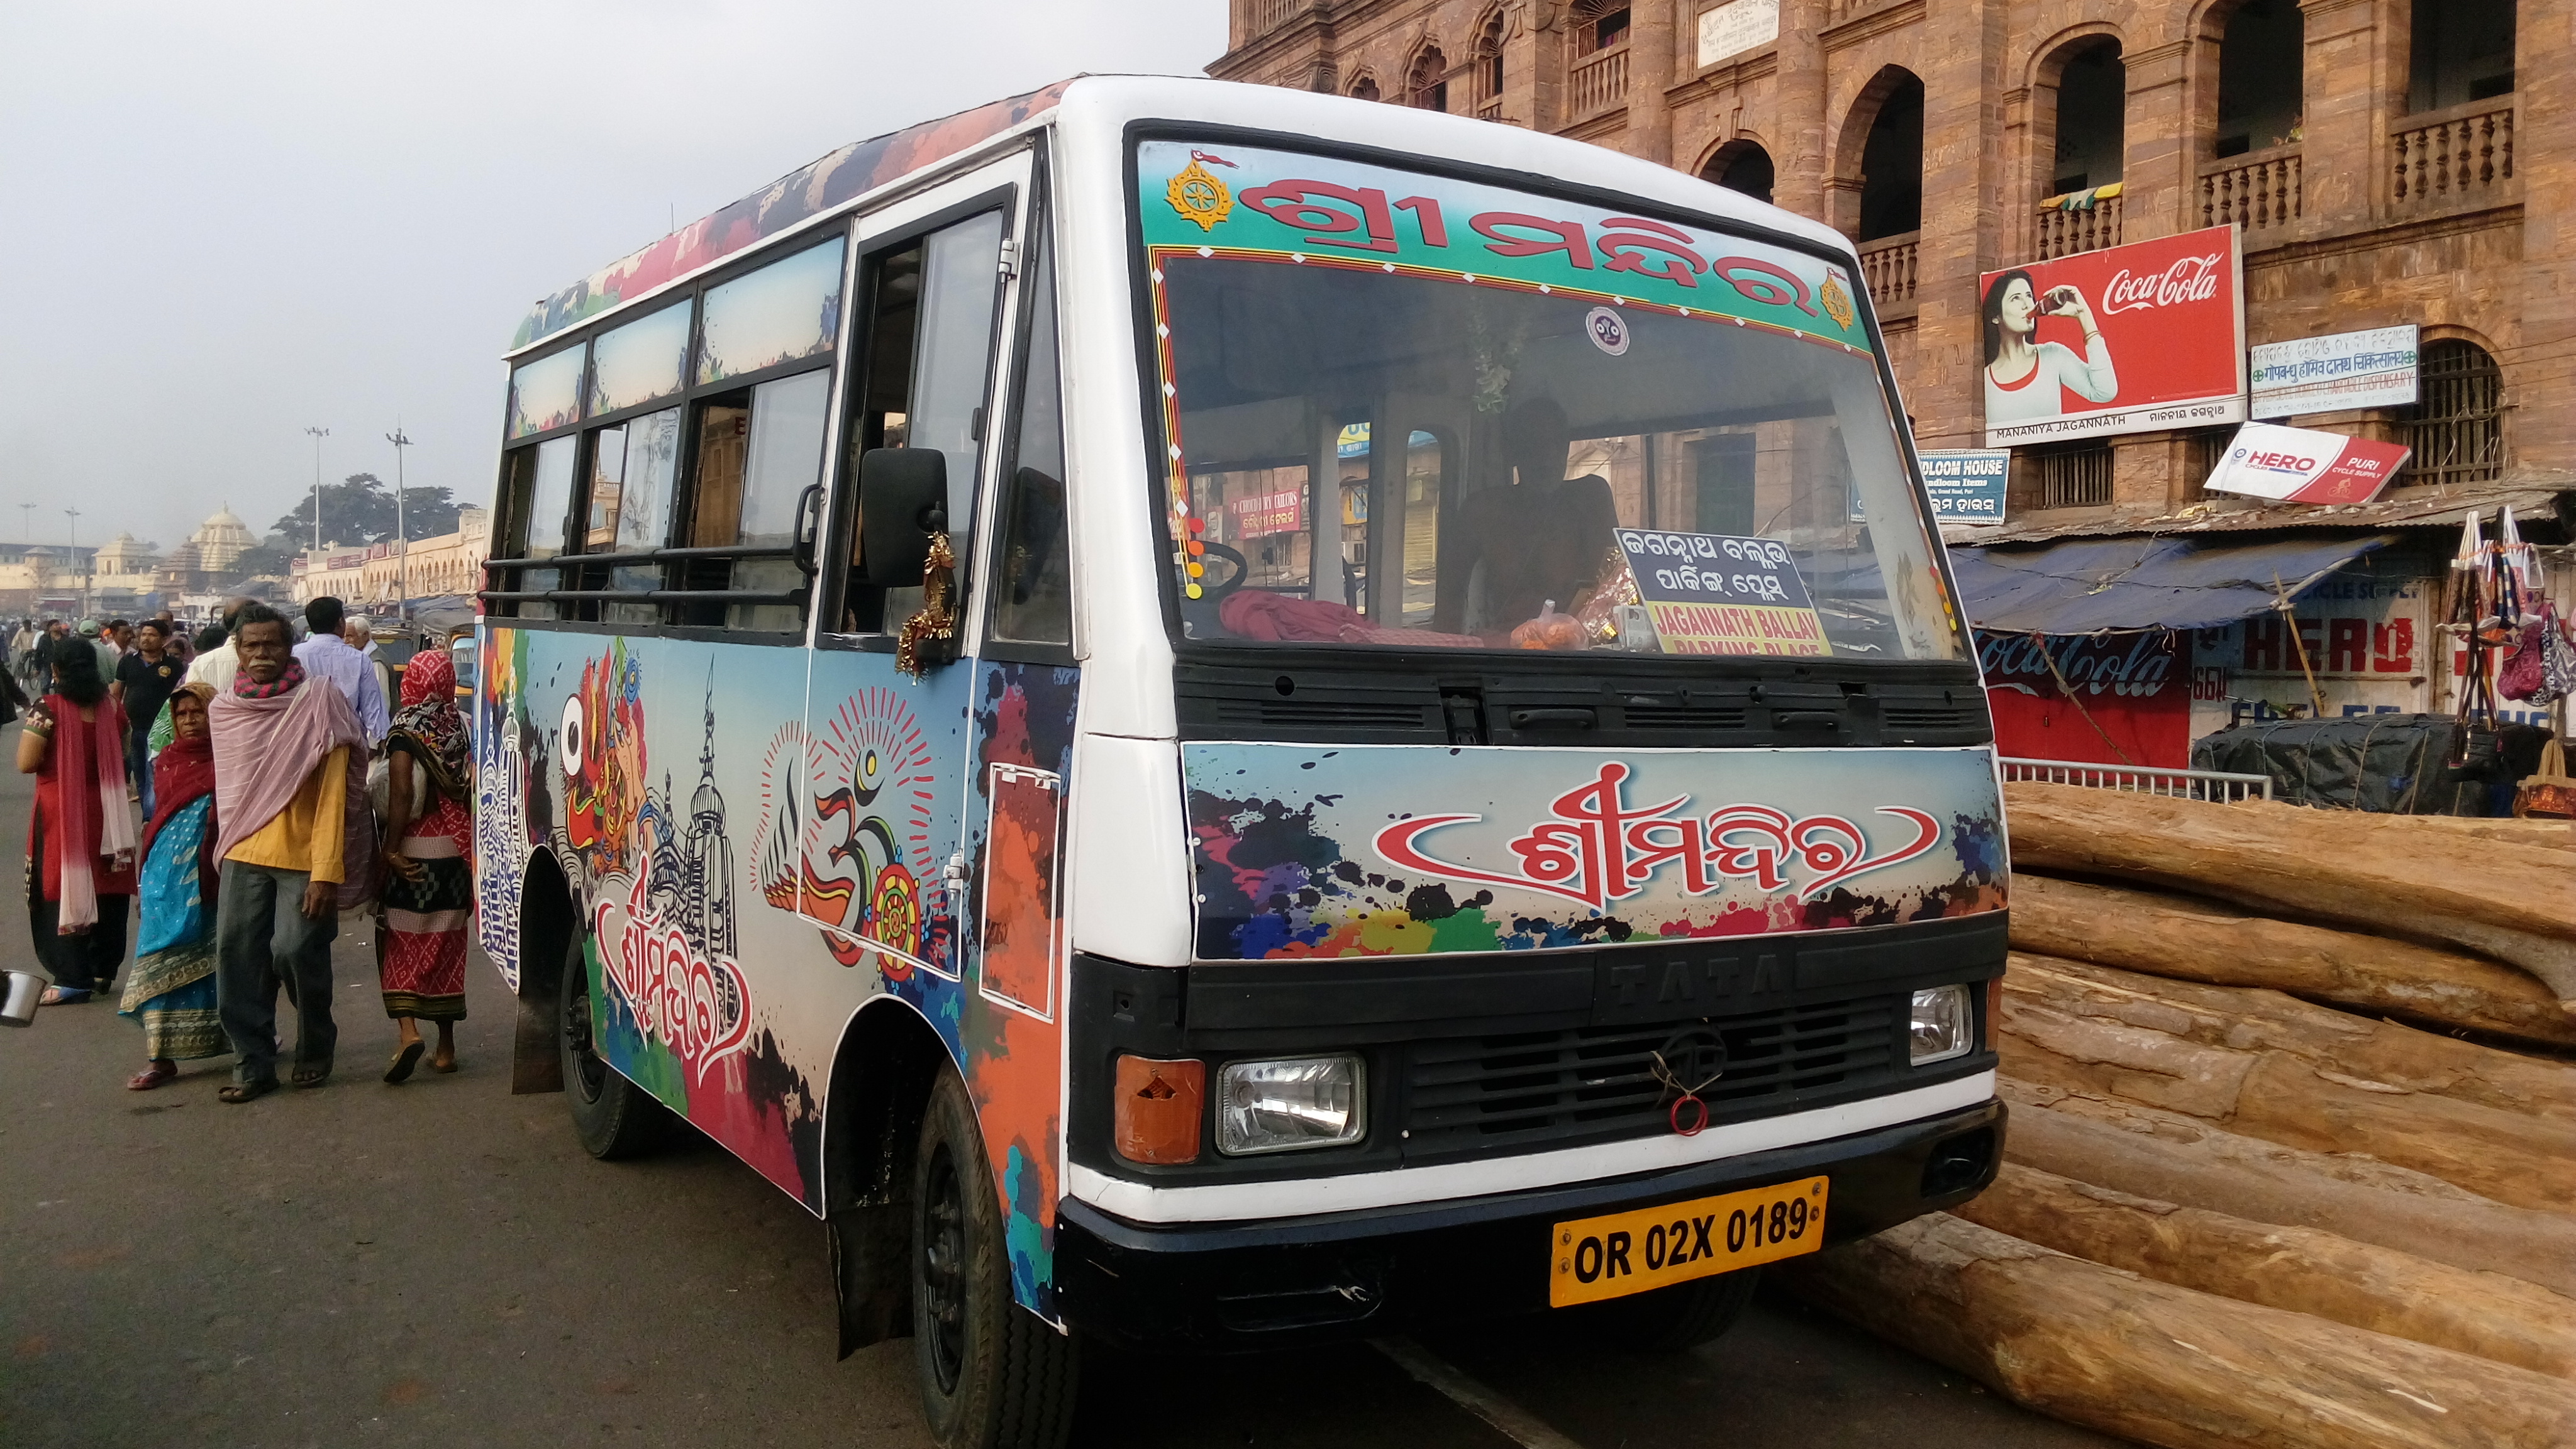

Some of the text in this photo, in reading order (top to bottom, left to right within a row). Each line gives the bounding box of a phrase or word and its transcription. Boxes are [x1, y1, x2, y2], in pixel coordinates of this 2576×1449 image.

[1238, 179, 1819, 318] ଶ୍ରୀ ମନ୍ଦିର
[2102, 252, 2224, 315] Coca-Cola
[1996, 416, 2126, 439] MANANIYA JAGANNATH
[1920, 459, 2004, 475] DLOOM HOUSE
[2248, 450, 2316, 471] HERO
[2332, 467, 2382, 479] CYCLE SUPPLY
[2346, 457, 2380, 470] PURI
[1621, 531, 1718, 564] ଜଗନ୍ନାଥ
[1654, 604, 1820, 641] JAGANNATH BALLAV
[1974, 630, 2172, 697] oca-Cola
[2244, 618, 2413, 672] HERO
[1610, 953, 1782, 1006] TATA
[1574, 1196, 1808, 1284] OR 02X 0189
